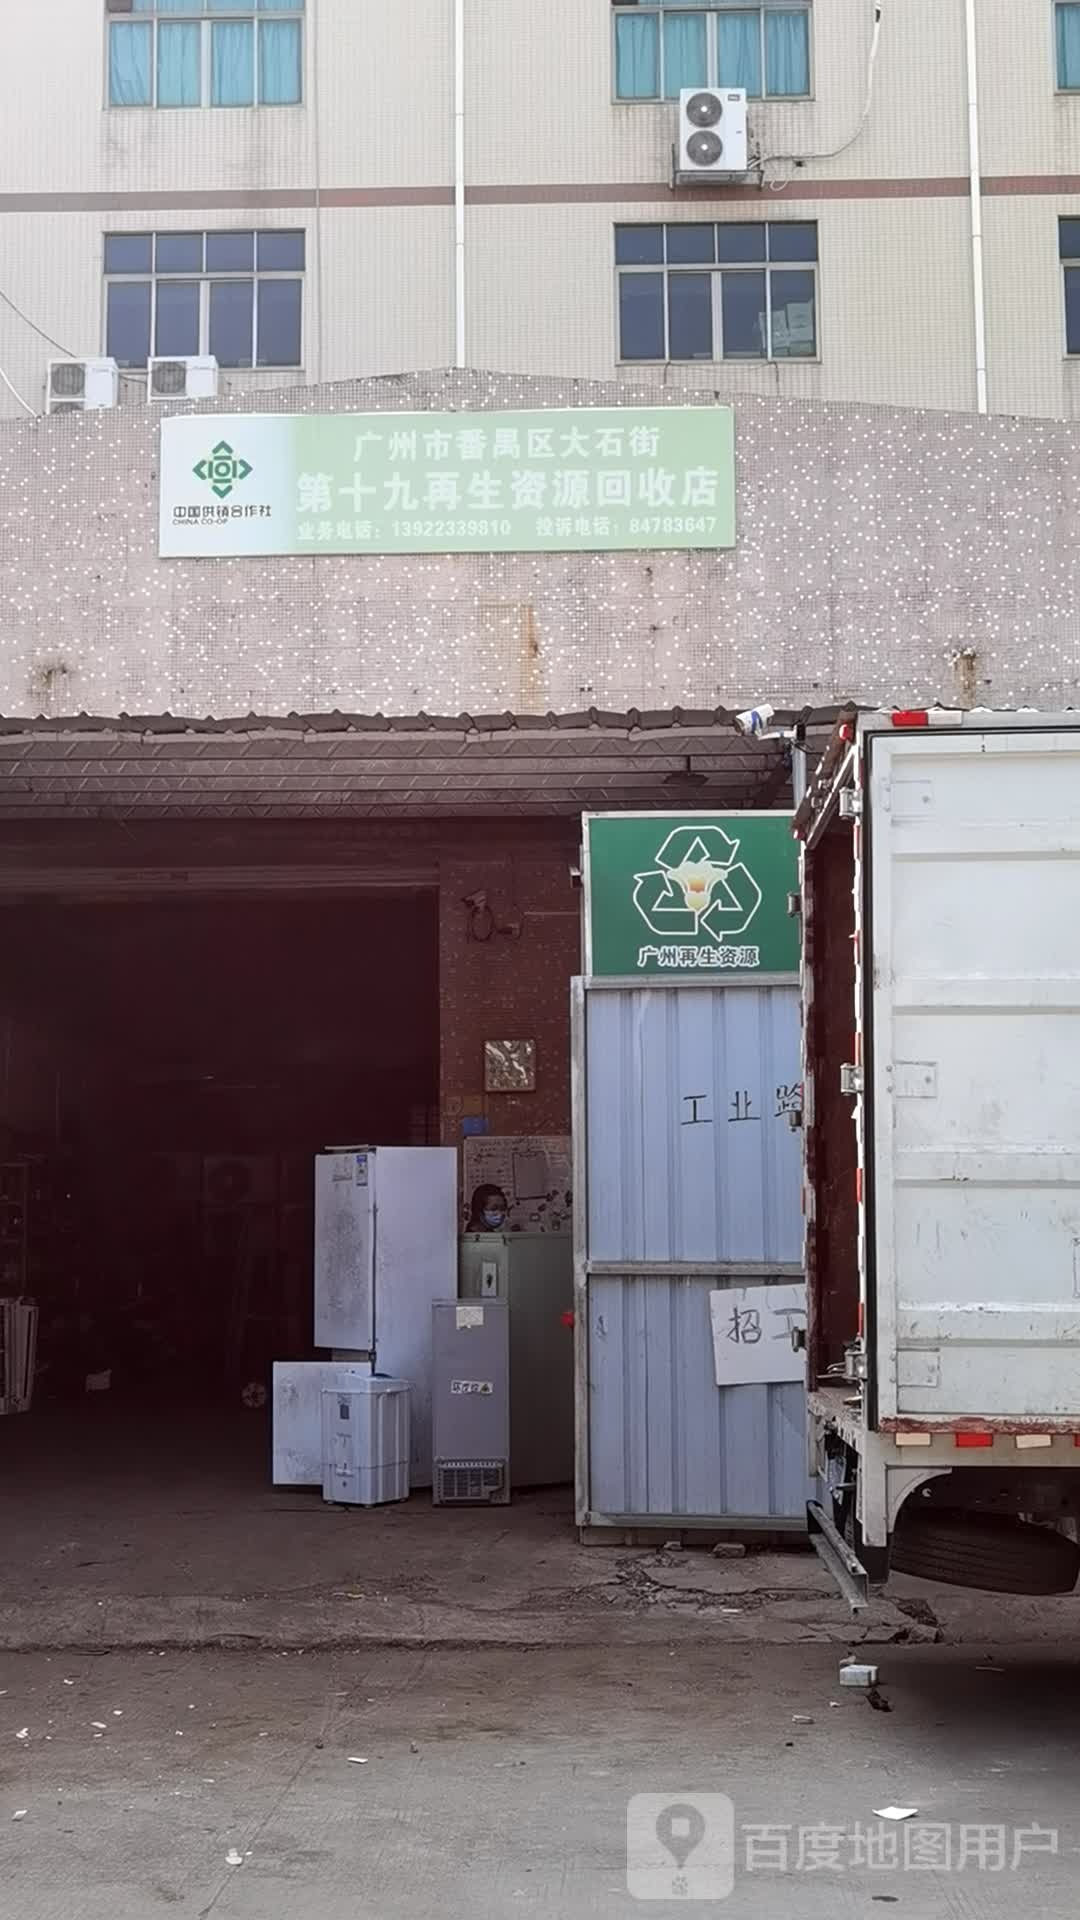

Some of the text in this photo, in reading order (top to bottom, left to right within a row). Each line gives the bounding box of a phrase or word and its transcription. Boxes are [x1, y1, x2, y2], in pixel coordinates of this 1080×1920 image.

[353, 426, 661, 463] 广州市番禺区大石街
[296, 466, 719, 513] 第十九再生资源回收店
[172, 504, 272, 518] 中国供销合作社
[172, 518, 199, 526] CHINA
[637, 945, 761, 968] 广州再生资源
